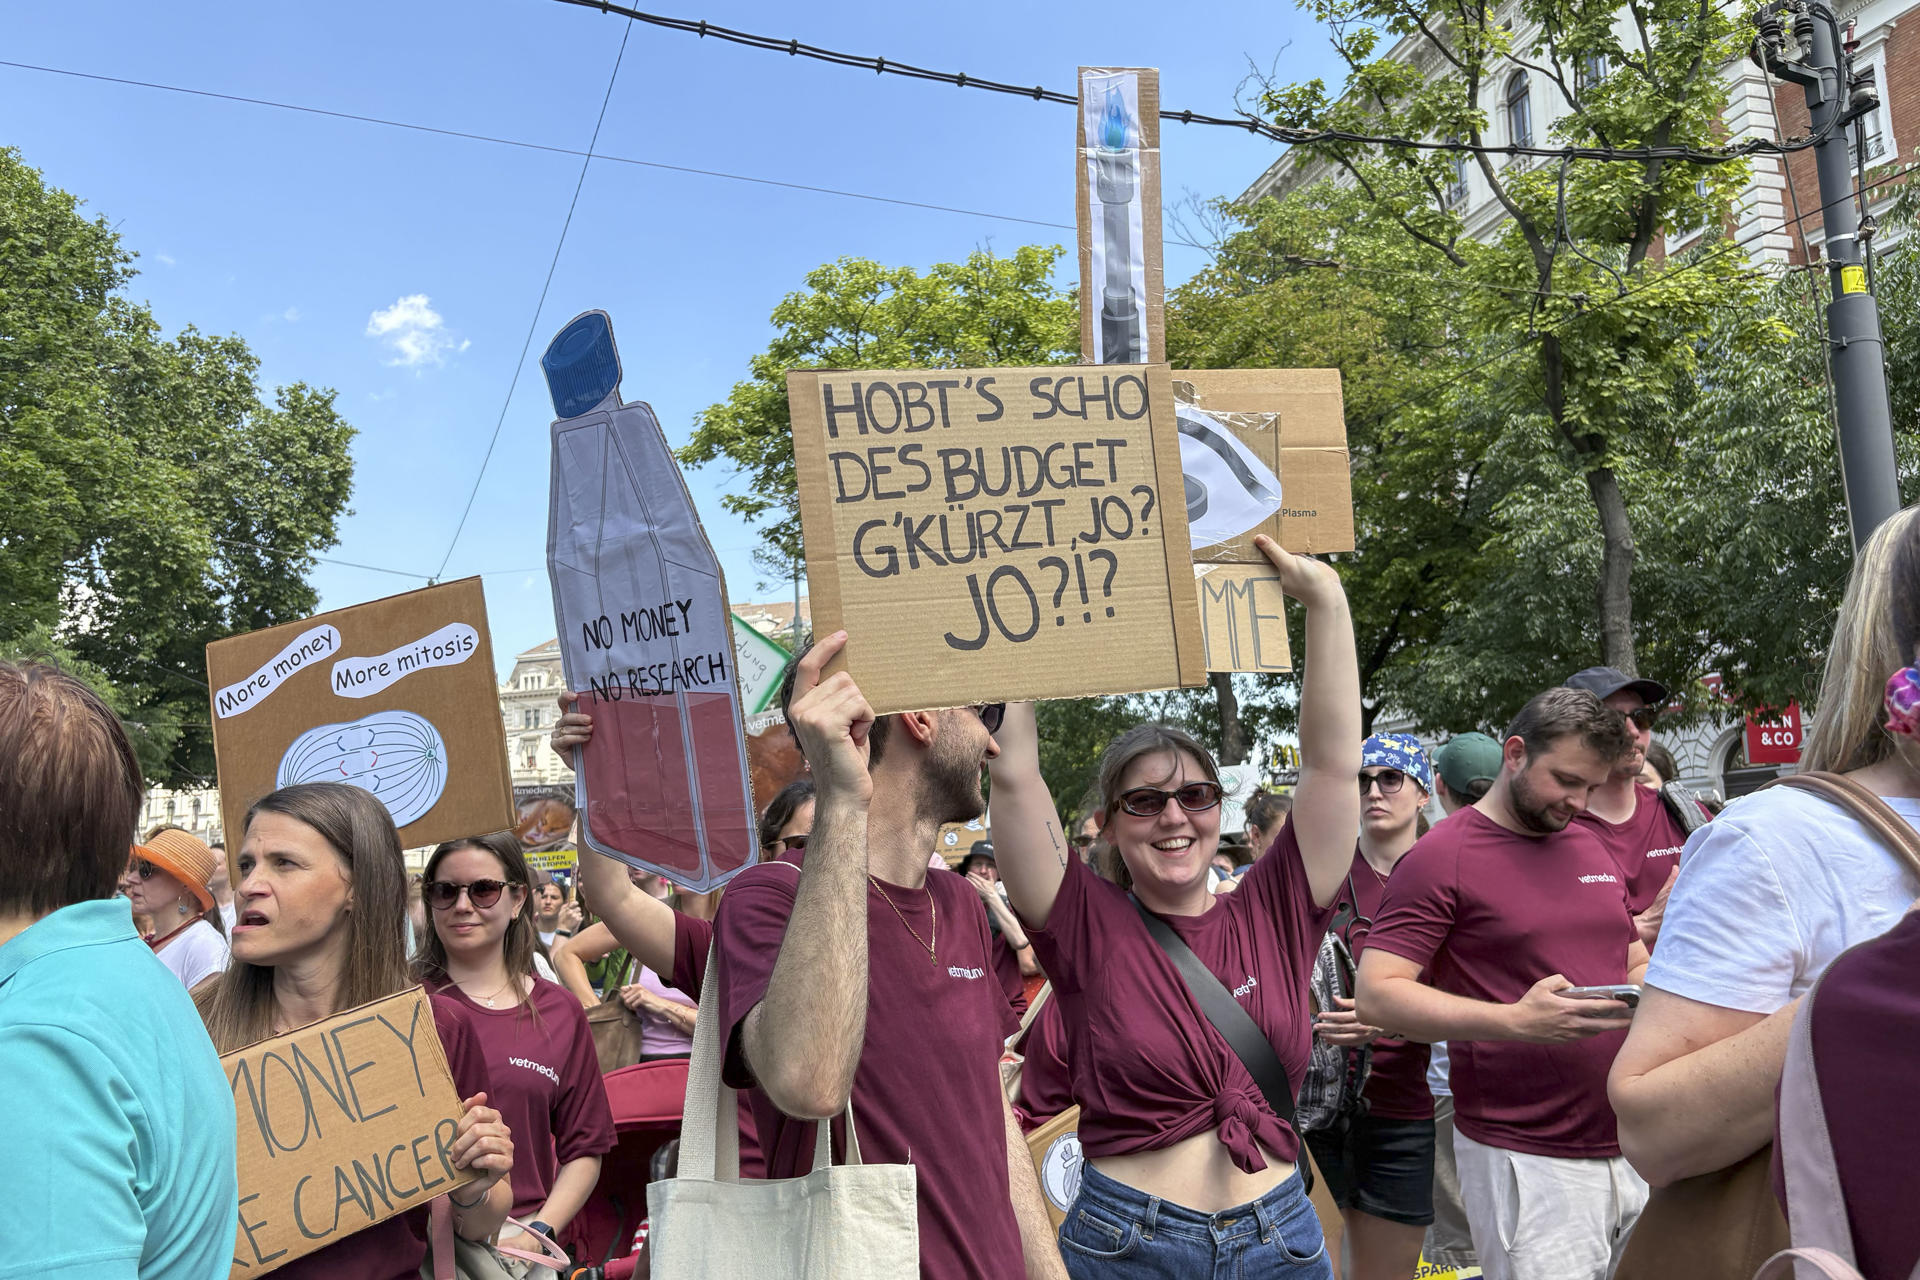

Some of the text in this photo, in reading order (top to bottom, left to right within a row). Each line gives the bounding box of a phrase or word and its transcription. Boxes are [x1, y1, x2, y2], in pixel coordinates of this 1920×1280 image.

[823, 375, 1148, 438] HOBT'S SCHO
[828, 438, 1128, 503] DES BUDGET
[1282, 508, 1317, 517] Plasma
[583, 599, 692, 652] NO MONEY
[943, 548, 1118, 651] JO?!?
[219, 629, 334, 715] More money
[335, 634, 474, 691] More mitosis
[590, 671, 622, 705] NO
[627, 652, 726, 698] RESEARCH
[294, 1118, 458, 1239] CANCER
